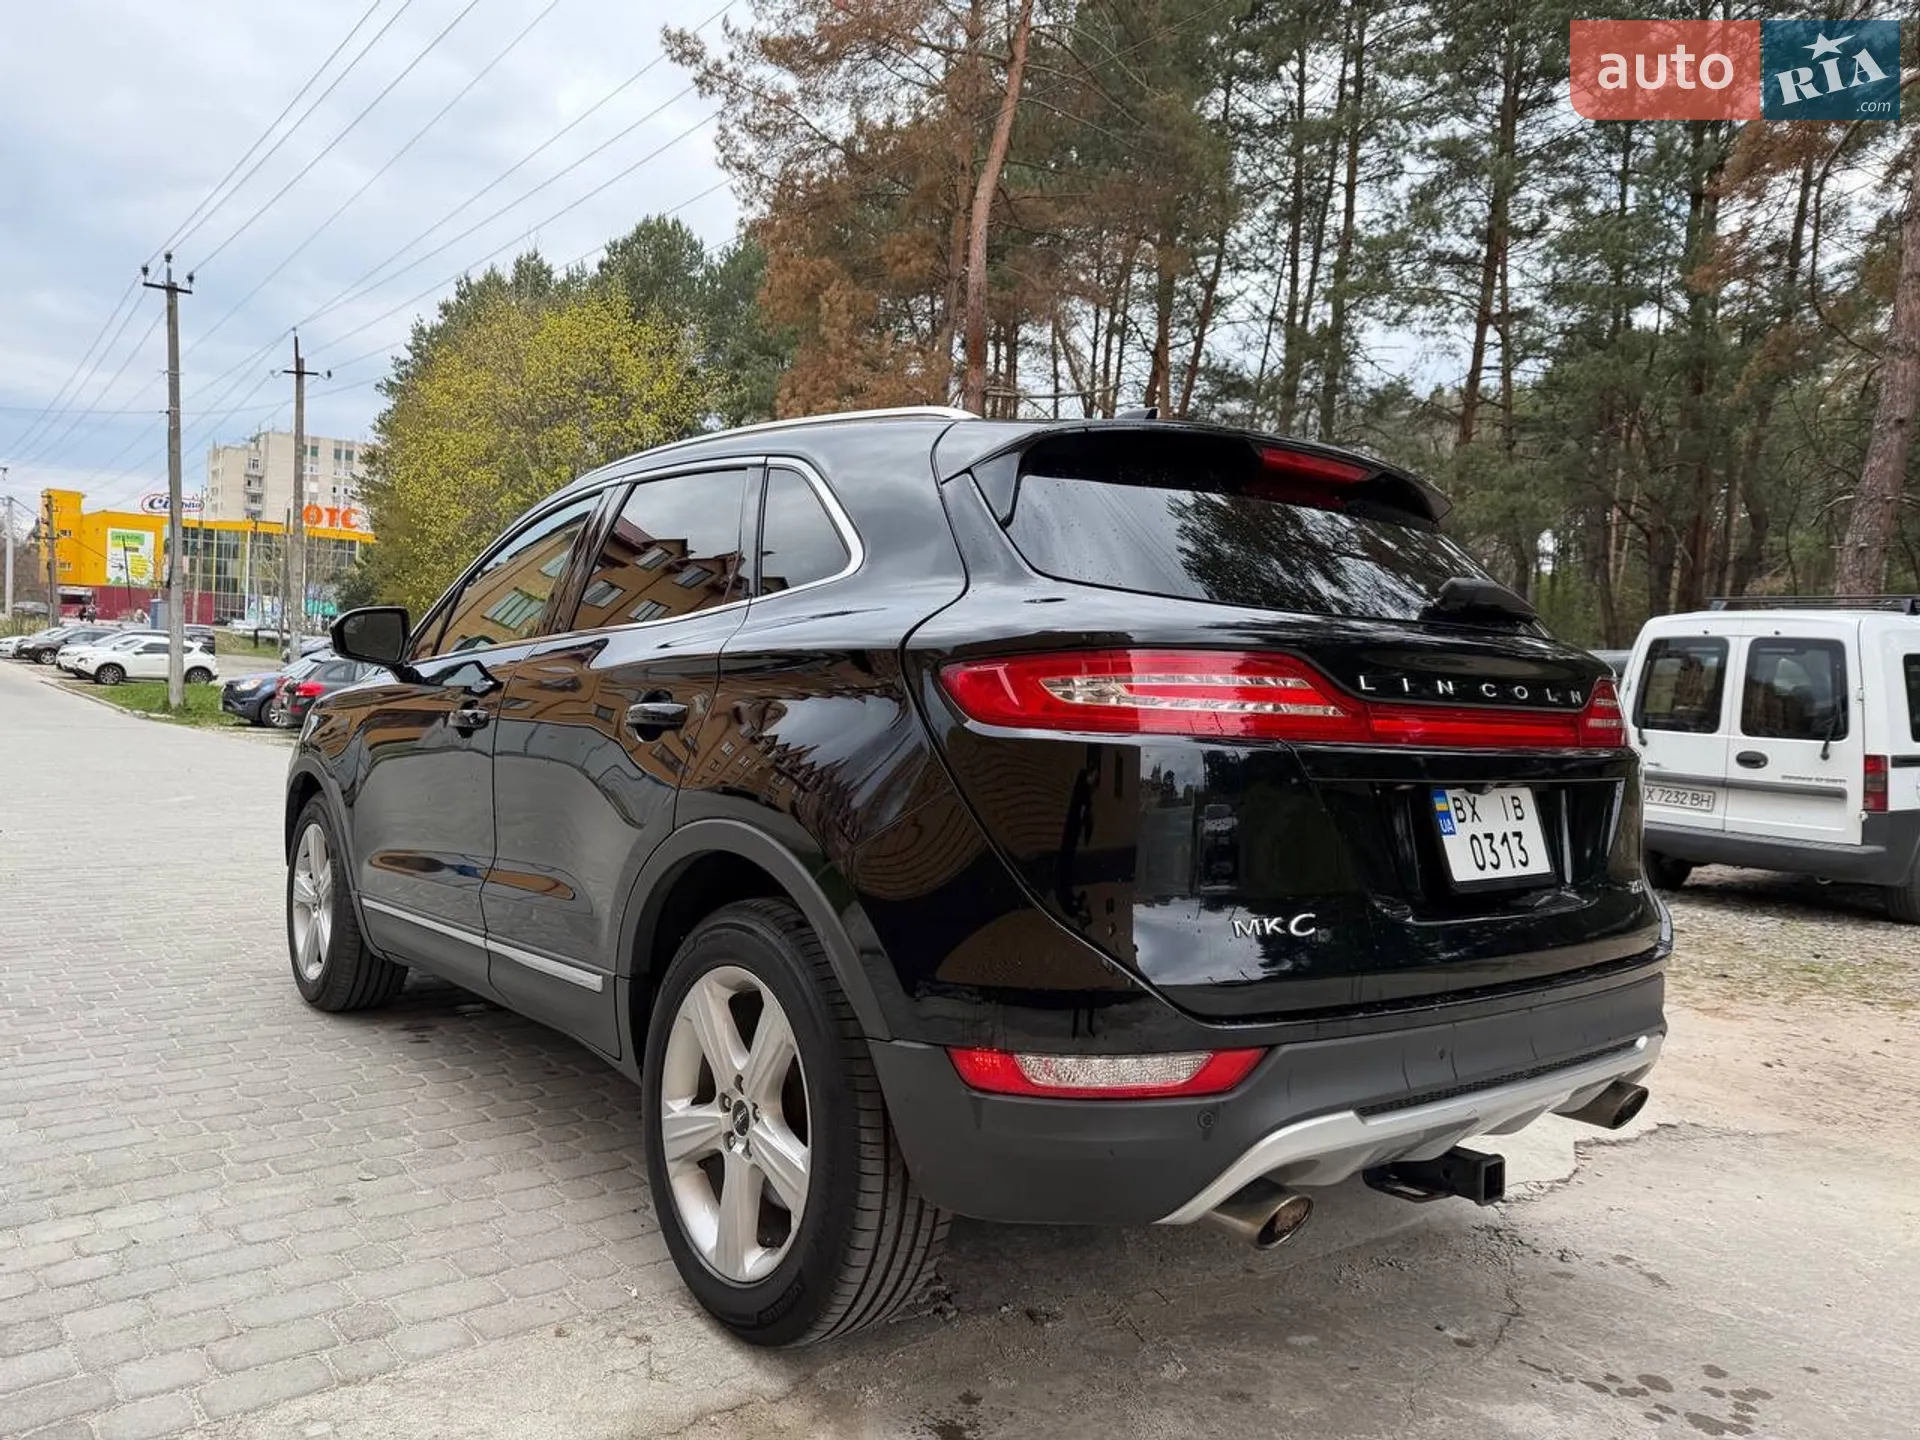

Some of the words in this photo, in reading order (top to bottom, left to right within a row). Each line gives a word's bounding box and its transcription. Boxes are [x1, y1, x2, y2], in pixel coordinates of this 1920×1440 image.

[1358, 674, 1583, 704] LINCOLN
[1452, 796, 1482, 823] BX
[1500, 795, 1525, 821] IB
[1658, 788, 1689, 805] 7232
[1690, 792, 1712, 808] BH
[1441, 818, 1457, 834] UA
[1469, 831, 1529, 871] 0313
[1231, 913, 1317, 938] MKC
